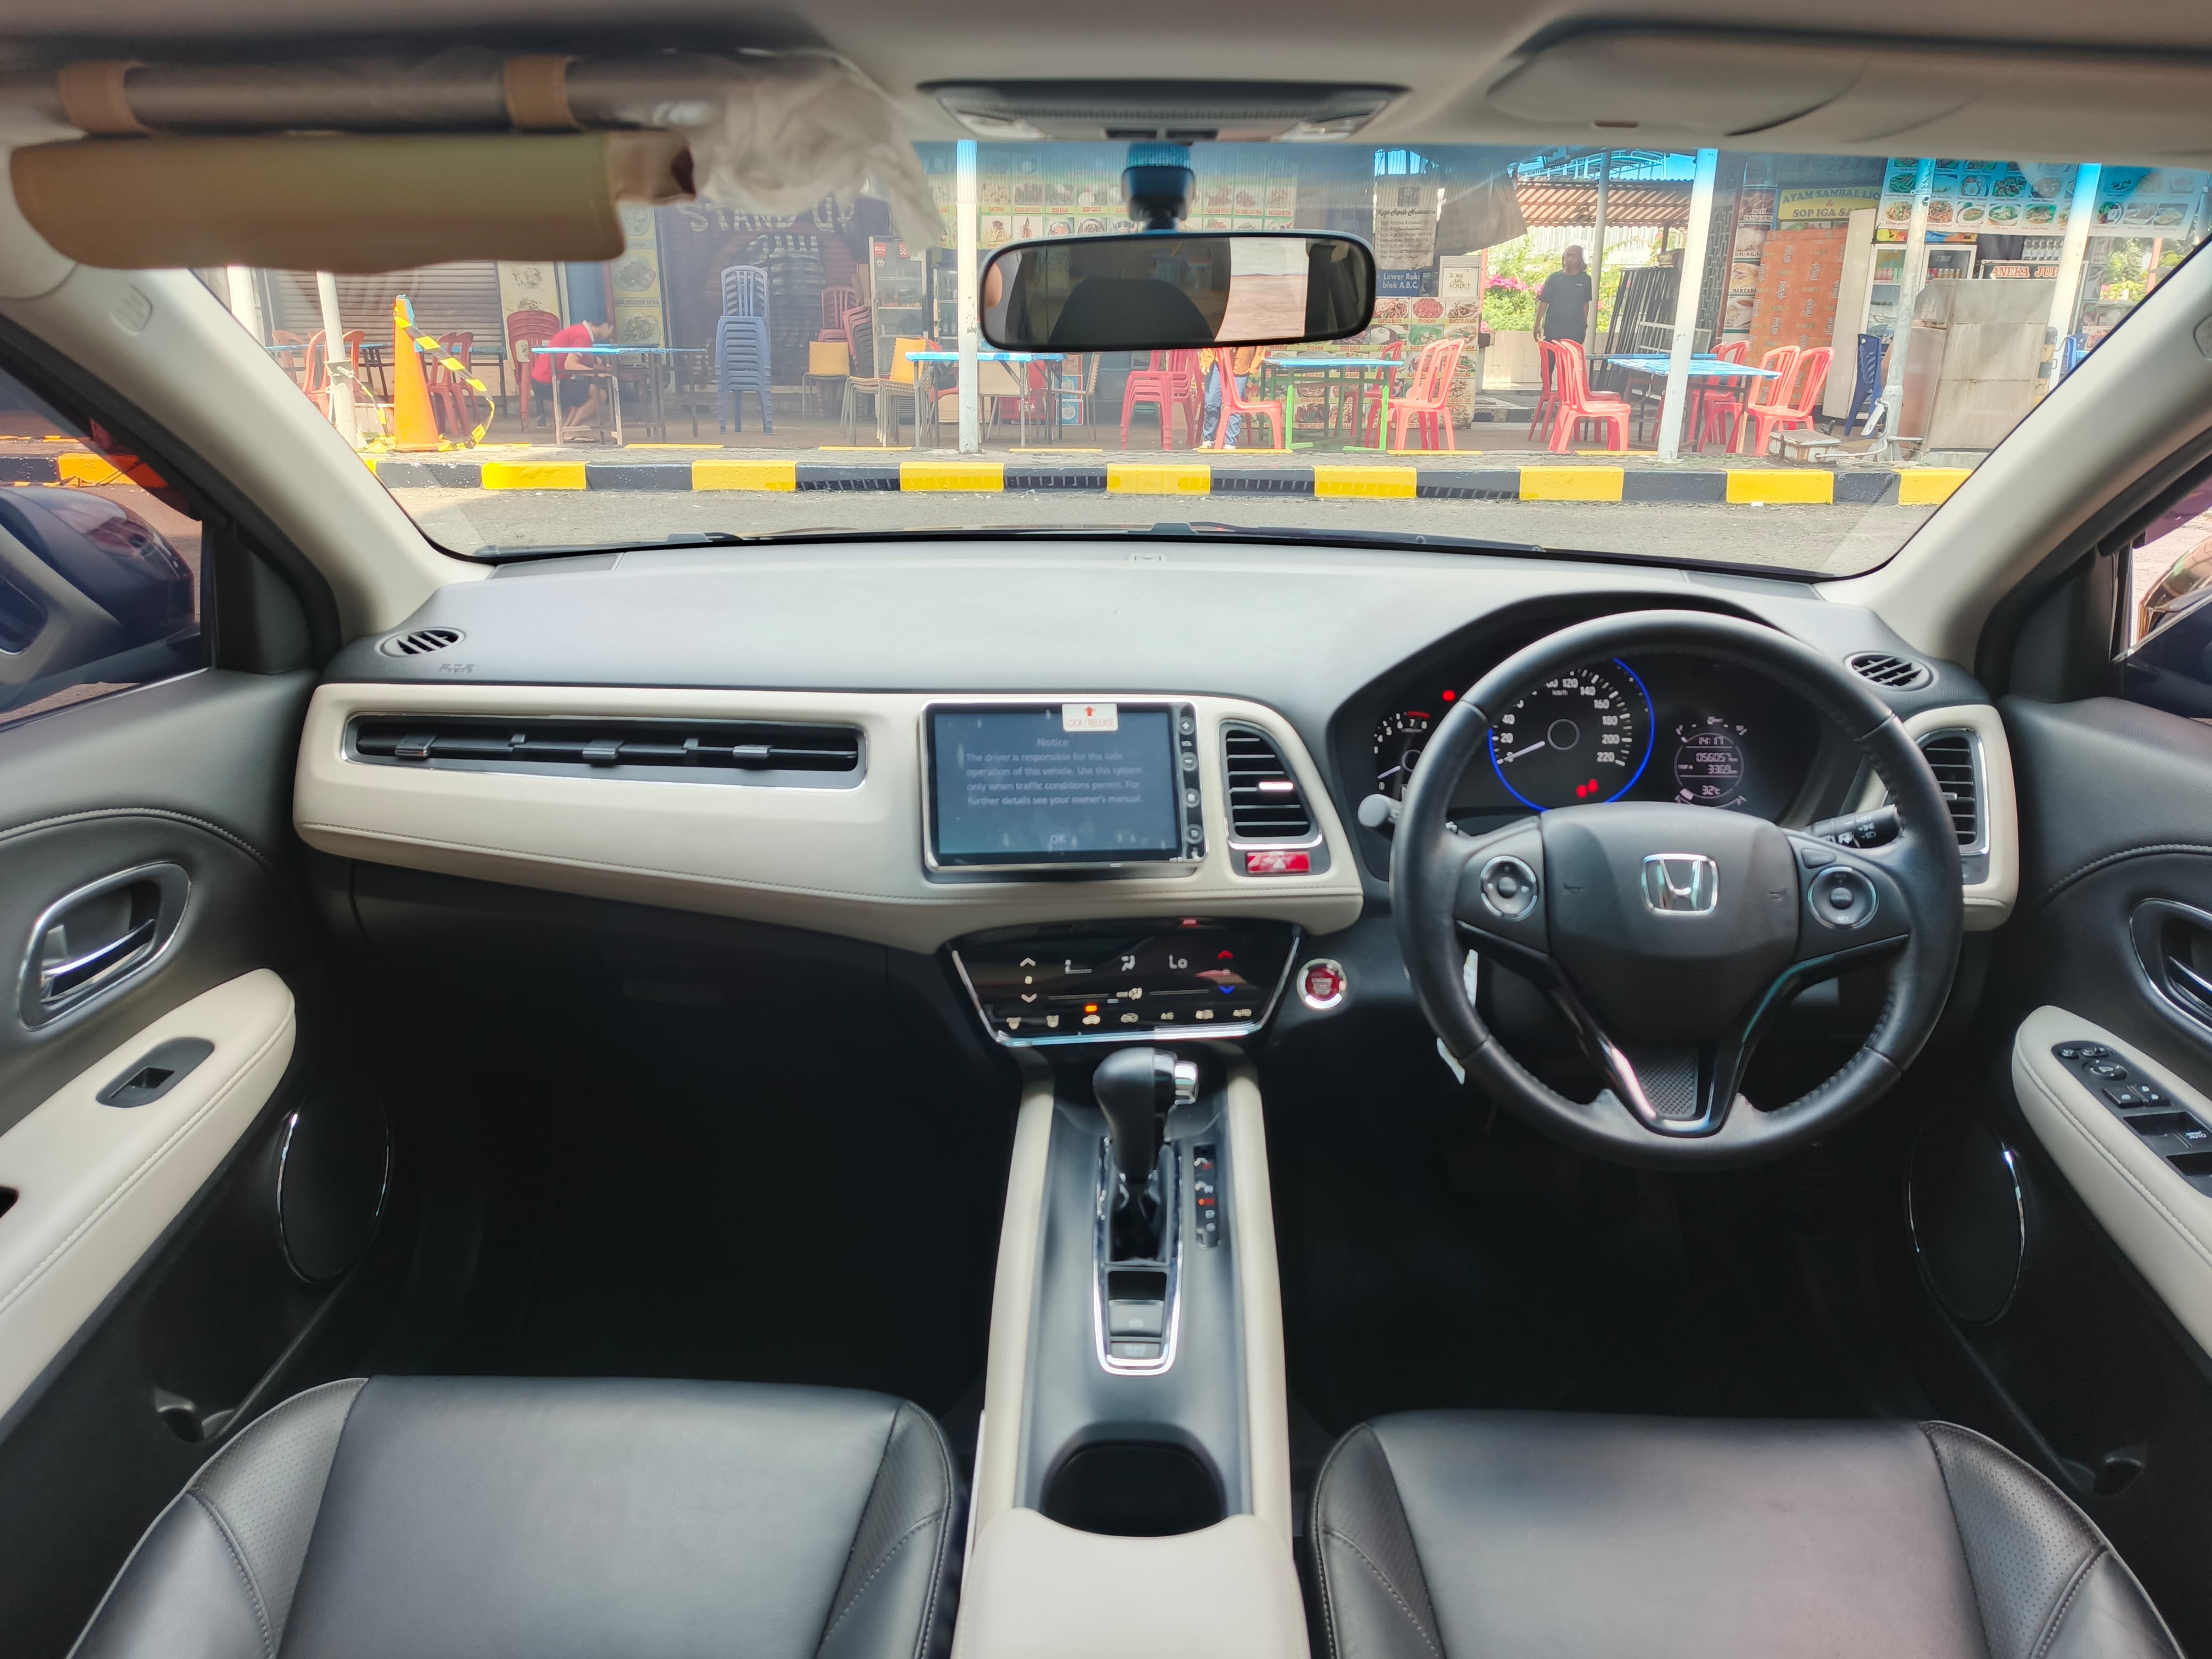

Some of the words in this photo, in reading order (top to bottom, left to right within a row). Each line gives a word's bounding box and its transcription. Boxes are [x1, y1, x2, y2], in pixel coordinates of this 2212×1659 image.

[1782, 191, 1813, 204] AYAM
[1816, 189, 1859, 198] SAMBAL
[1792, 208, 1814, 217] SOP
[1992, 266, 2030, 278] ANEKA
[2034, 266, 2057, 277] JUI
[1563, 678, 1578, 688] 120
[1580, 686, 1596, 696] 140
[1594, 699, 1610, 709] 160
[1067, 719, 1083, 727] LOCK
[1088, 719, 1115, 727] RELEASE
[1502, 714, 1515, 725] 40
[1602, 715, 1618, 725] 180
[1386, 727, 1392, 735] 5
[1037, 737, 1069, 747] Notice
[1501, 733, 1514, 743] 20
[1602, 734, 1620, 744] 200
[966, 753, 983, 762] The
[1020, 753, 1071, 762] responsible
[1073, 752, 1085, 761] for
[1088, 752, 1102, 761] the
[1104, 751, 1123, 760] safe
[1597, 752, 1615, 762] 220
[966, 769, 1010, 777] operation
[1012, 766, 1024, 776] of
[1025, 767, 1041, 776] this
[1112, 767, 1142, 776] system
[966, 783, 986, 792] only
[987, 783, 1015, 791] when
[1016, 781, 1043, 791] traffic
[1044, 781, 1090, 791] conditions
[1125, 780, 1140, 788] For
[967, 797, 999, 805] further
[1001, 796, 1031, 805] details
[1049, 797, 1070, 807] your
[1071, 794, 1107, 803] owner's
[1050, 833, 1066, 844] OK
